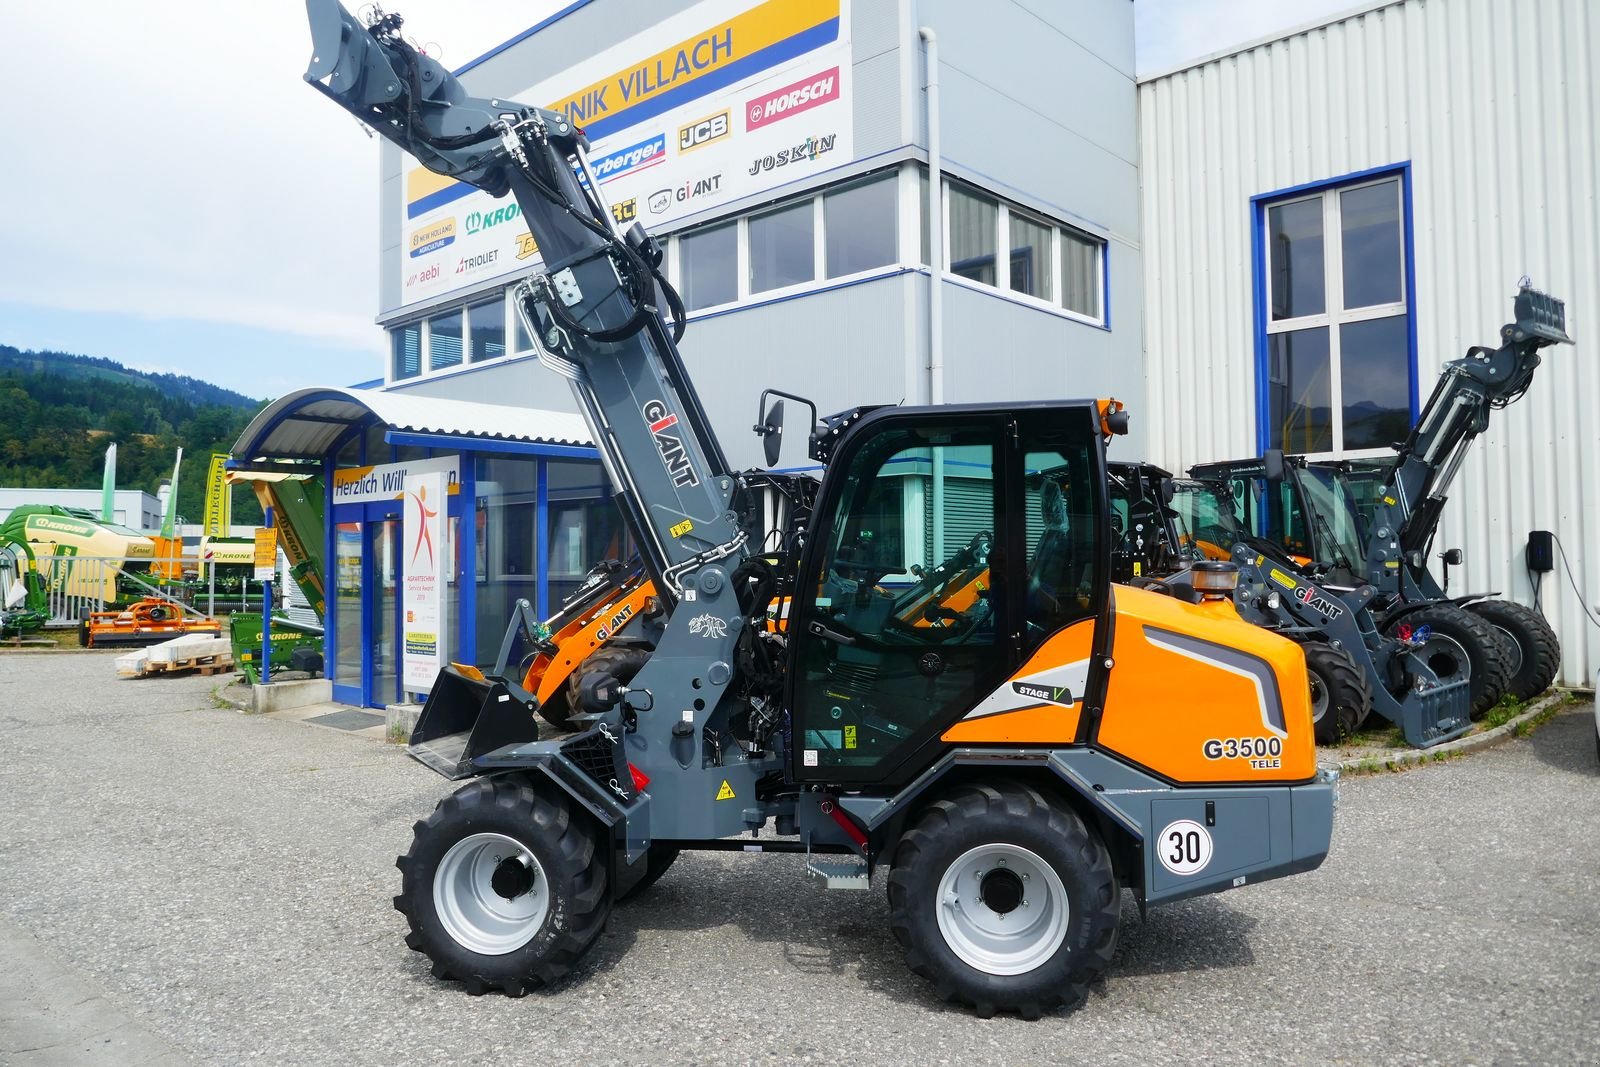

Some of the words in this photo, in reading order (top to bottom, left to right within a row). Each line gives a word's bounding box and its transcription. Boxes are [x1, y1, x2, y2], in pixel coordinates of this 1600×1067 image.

[618, 28, 732, 103] VILLACH
[764, 76, 834, 118] HORSCH
[681, 114, 728, 149] JCB
[748, 133, 837, 176] JOSKIN
[419, 232, 430, 242] NEW
[430, 224, 453, 238] HOLLAND
[419, 240, 445, 254] AGRICULTURE
[464, 249, 499, 270] TRIOLIET
[419, 263, 440, 283] aebi
[335, 473, 377, 496] Herzlich
[47, 521, 89, 534] KRONE
[1019, 685, 1050, 700] STAGE
[1053, 686, 1066, 701] V
[1203, 737, 1282, 760] G3500
[1250, 758, 1281, 770] TELE
[1168, 831, 1201, 865] 30
